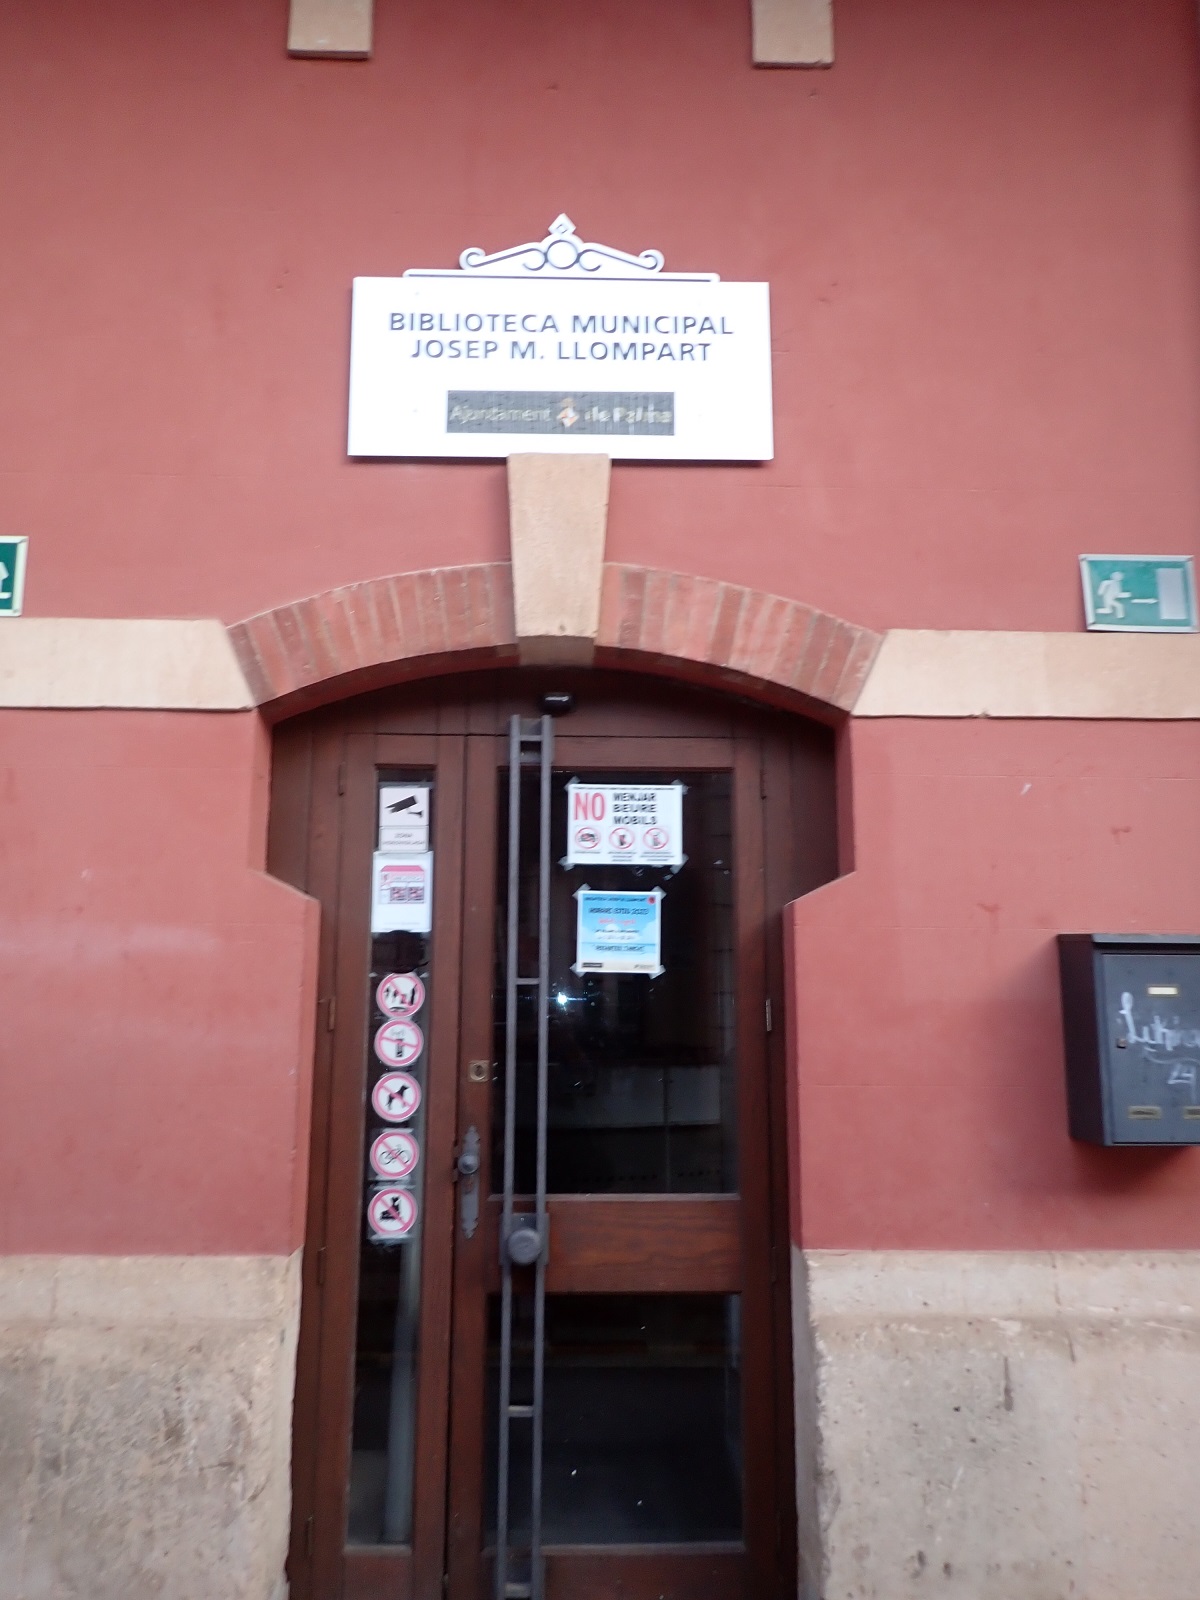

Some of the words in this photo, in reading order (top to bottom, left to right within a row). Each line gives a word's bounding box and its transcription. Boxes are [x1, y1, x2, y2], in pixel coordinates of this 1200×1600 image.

[389, 312, 560, 333] BIBLIOTECA
[571, 315, 734, 335] MUNICIPAL
[411, 339, 499, 359] JOSEP
[511, 341, 545, 360] M.
[558, 341, 712, 361] LLOMPART
[585, 406, 609, 422] de
[613, 404, 672, 424] Palma
[574, 792, 605, 821] NO
[613, 803, 657, 813] BEURE
